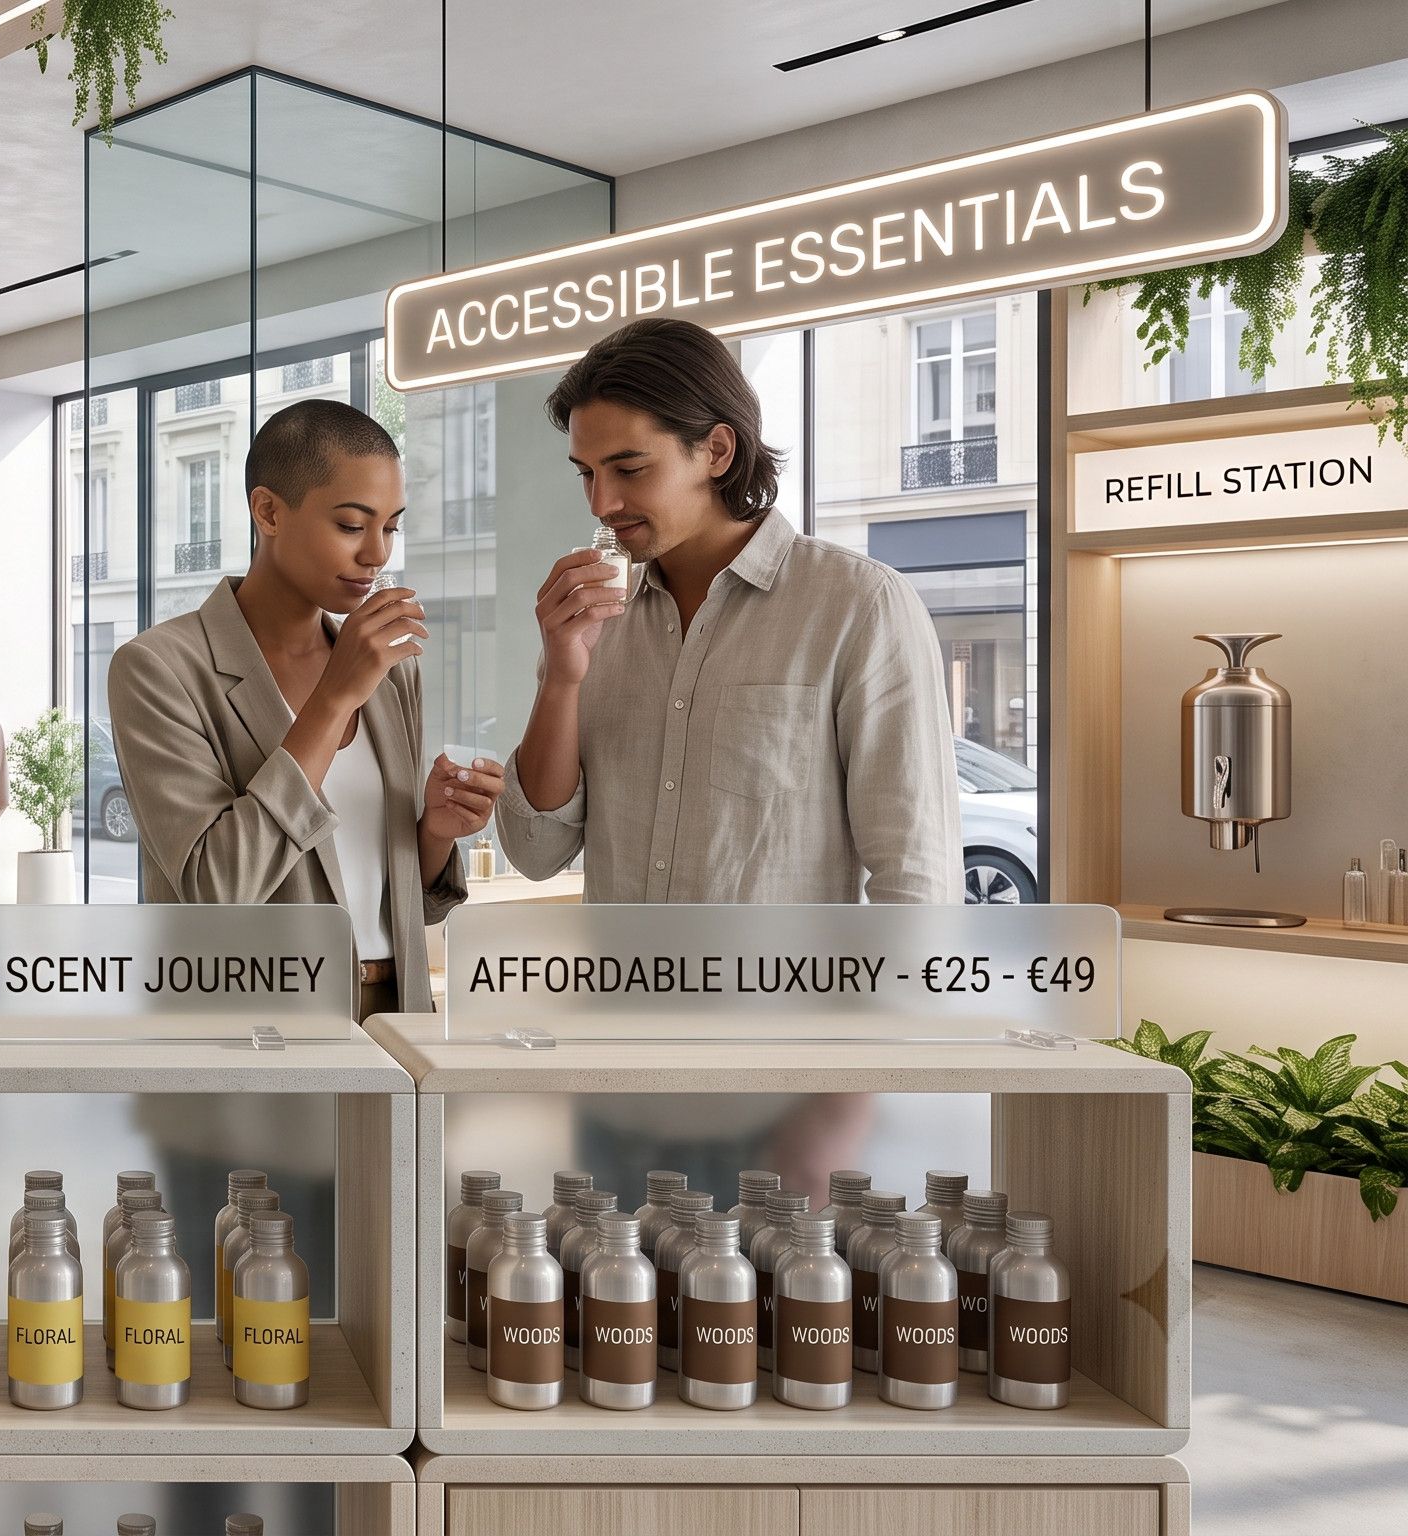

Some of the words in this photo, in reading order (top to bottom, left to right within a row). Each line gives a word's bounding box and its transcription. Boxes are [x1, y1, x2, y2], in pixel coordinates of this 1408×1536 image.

[425, 248, 734, 354] ACCESSIBLE
[754, 160, 1166, 292] ESSENTIALS
[1106, 471, 1212, 504] REFILL
[1223, 455, 1372, 495] STATION
[5, 956, 133, 993] SCENT
[144, 956, 325, 993] JOURNEY
[469, 956, 723, 993] AFFORDABLE
[737, 956, 886, 993] LUXURY
[921, 956, 990, 993] €25
[1027, 956, 1095, 993] €49
[16, 1326, 76, 1345] FLORAL
[125, 1326, 185, 1345] FLORAL
[244, 1327, 304, 1345] FLORAL
[503, 1326, 561, 1345] WOODS
[595, 1326, 653, 1345] WOODS
[696, 1326, 754, 1345] WOODS
[792, 1326, 850, 1345] WOODS
[896, 1325, 955, 1345] WOODS
[1009, 1326, 1068, 1345] WOODS
